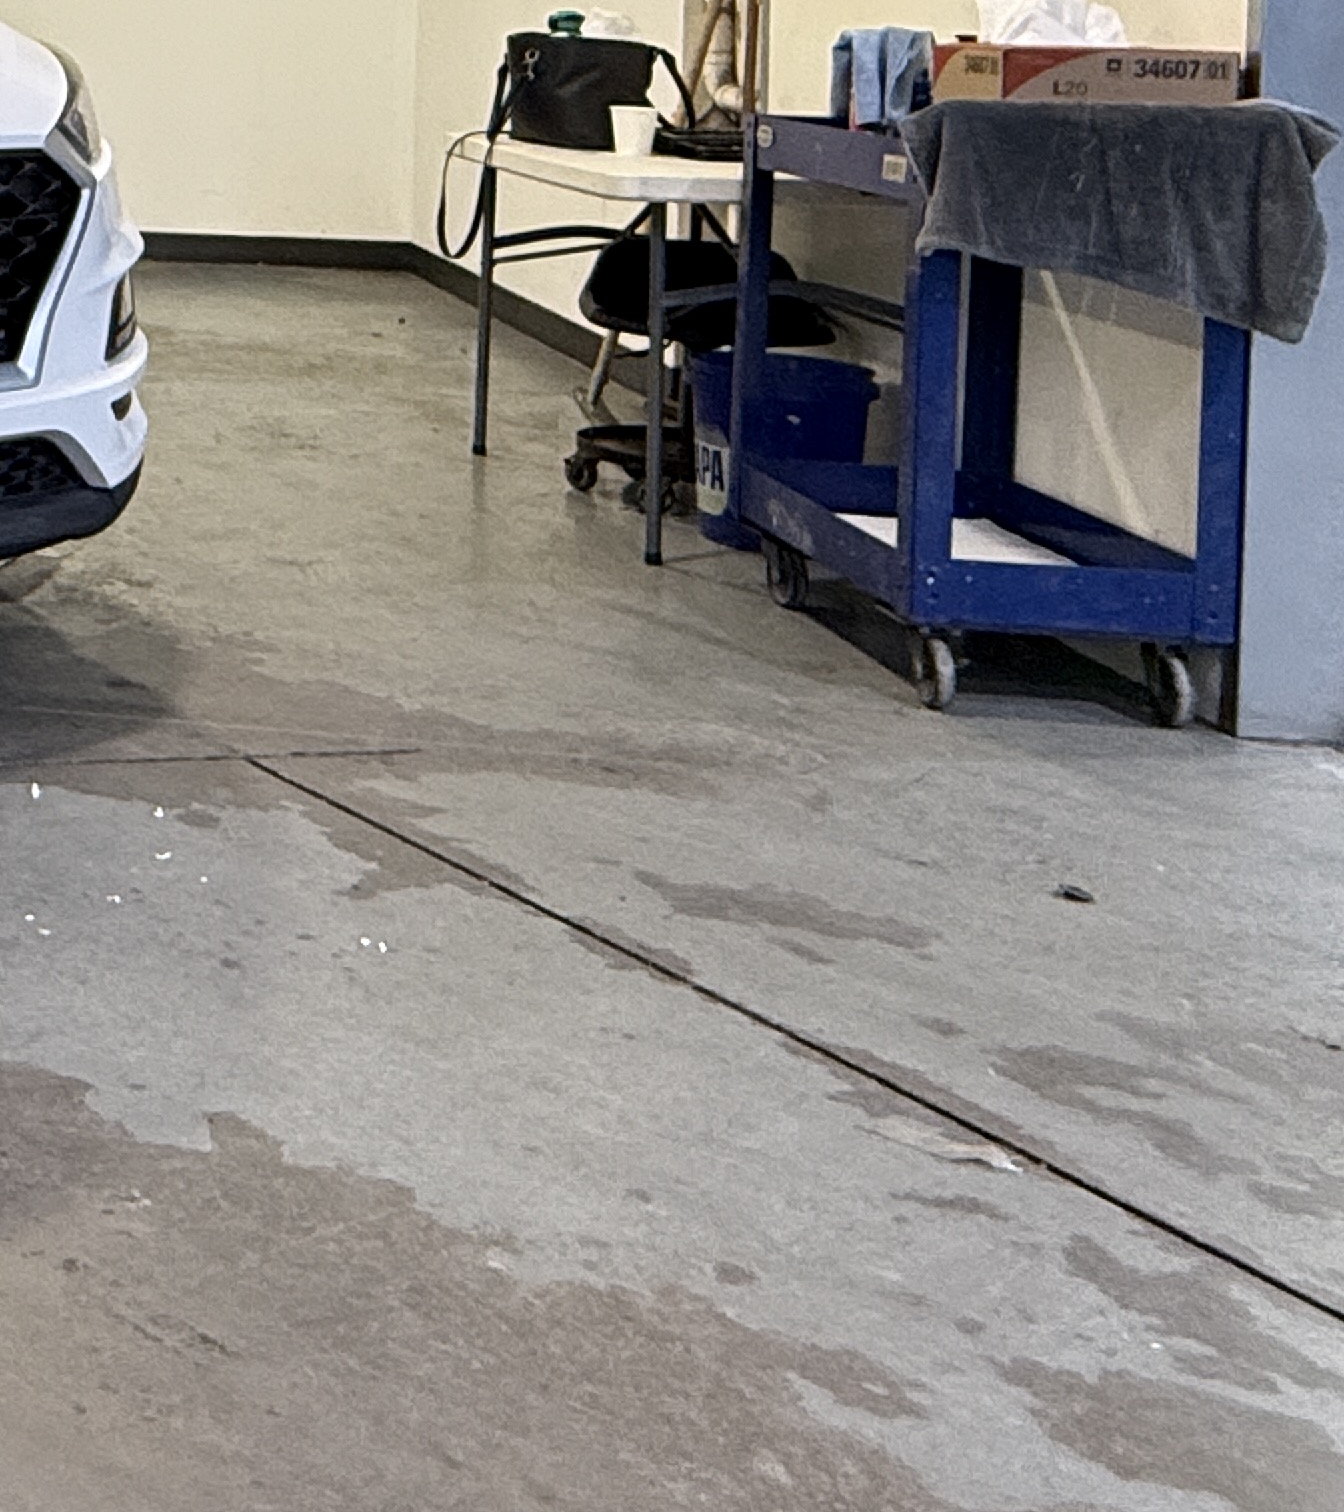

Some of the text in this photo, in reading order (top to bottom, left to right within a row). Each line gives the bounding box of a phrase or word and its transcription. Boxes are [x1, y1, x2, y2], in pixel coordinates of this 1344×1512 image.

[1132, 58, 1201, 80] 34607
[1052, 80, 1088, 96] L20
[697, 445, 726, 493] PA
